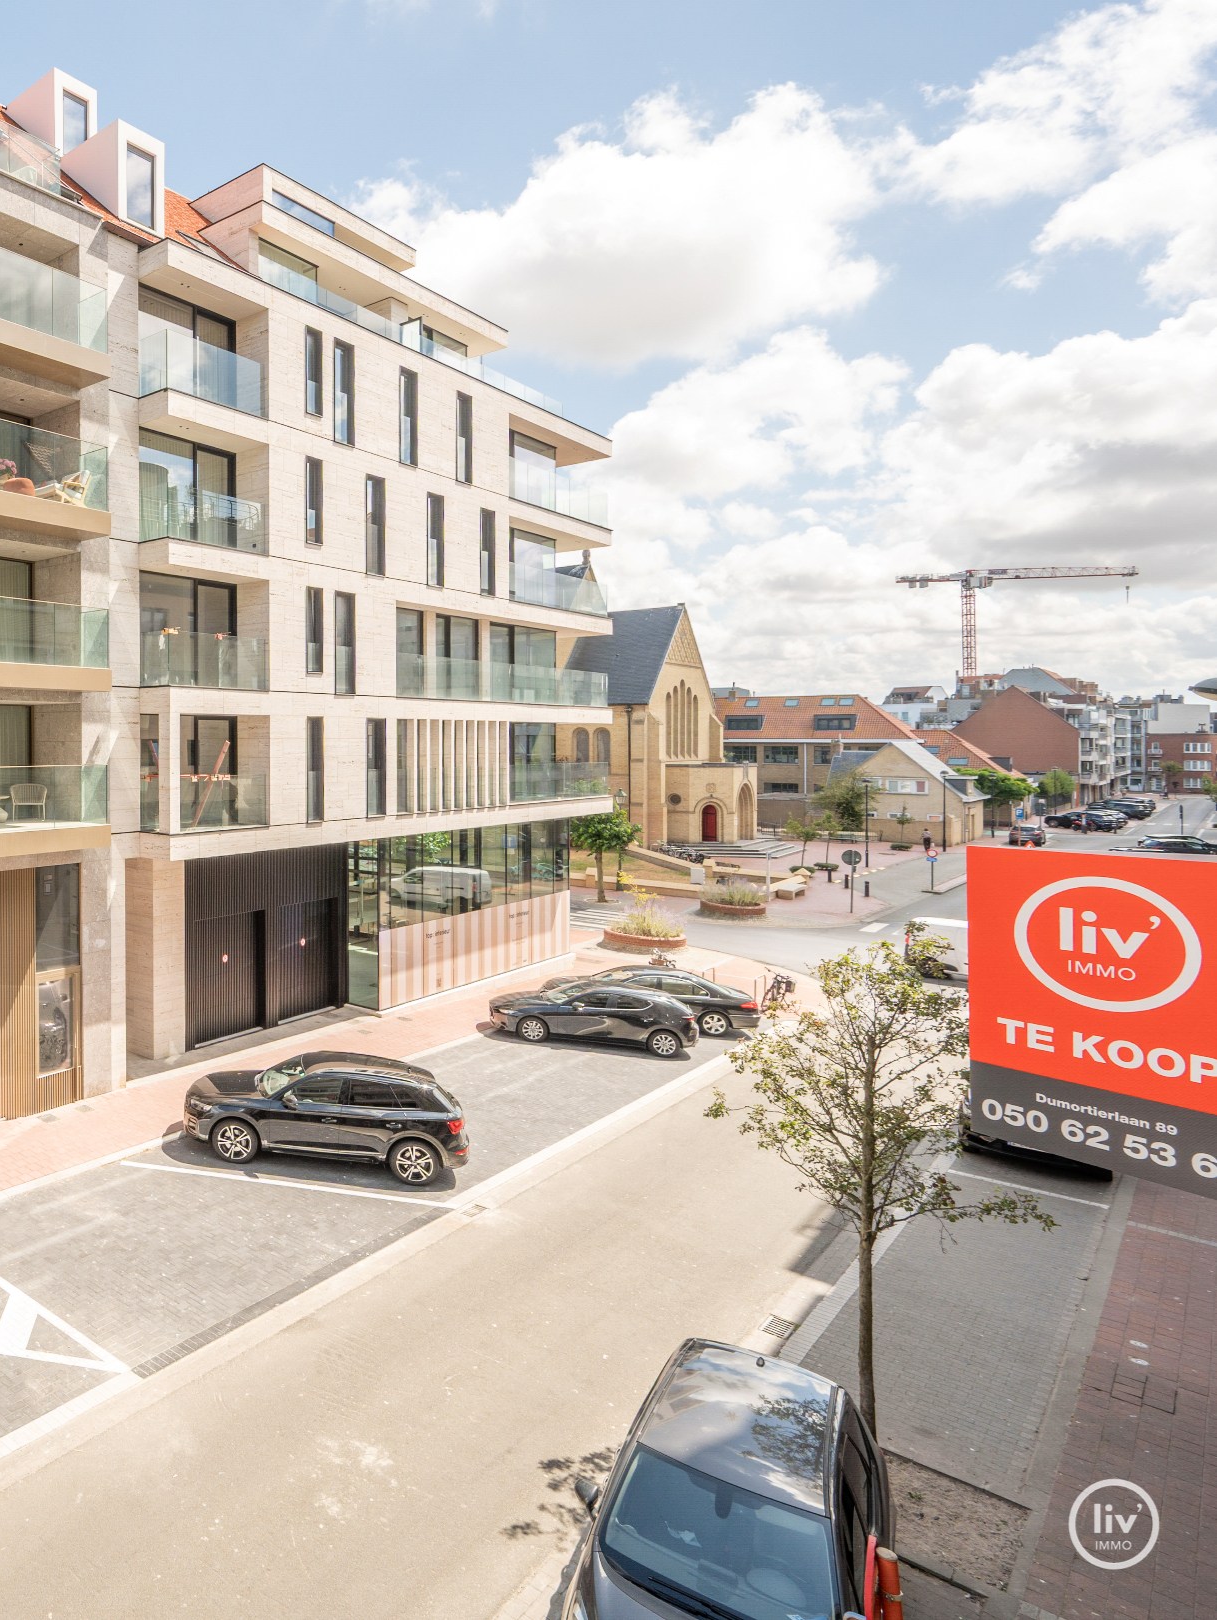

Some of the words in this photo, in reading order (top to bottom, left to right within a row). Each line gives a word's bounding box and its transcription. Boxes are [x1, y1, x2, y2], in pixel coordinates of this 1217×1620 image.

[1067, 959, 1136, 981] IMMO
[996, 1016, 1055, 1053] TE
[1072, 1031, 1217, 1084] KOOP
[981, 1098, 1049, 1133] 050
[1060, 1119, 1111, 1151] 62
[1122, 1133, 1178, 1168] 53
[1035, 1092, 1151, 1130] Dumortierlaan
[1154, 1121, 1179, 1136] 89
